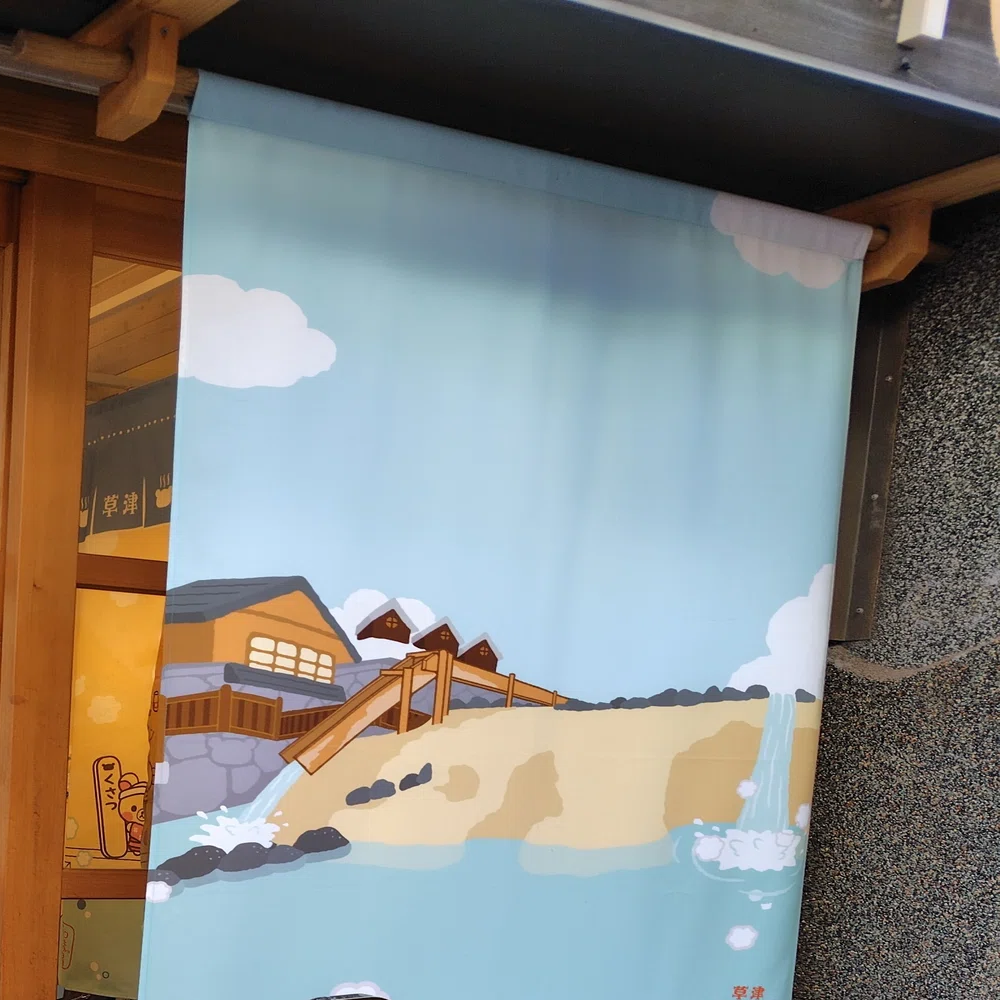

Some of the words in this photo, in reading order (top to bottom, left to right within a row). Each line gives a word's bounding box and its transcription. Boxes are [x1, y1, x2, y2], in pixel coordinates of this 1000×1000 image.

[103, 491, 139, 517] 草津
[103, 773, 117, 811] くさつ
[732, 985, 766, 1000] 草津
